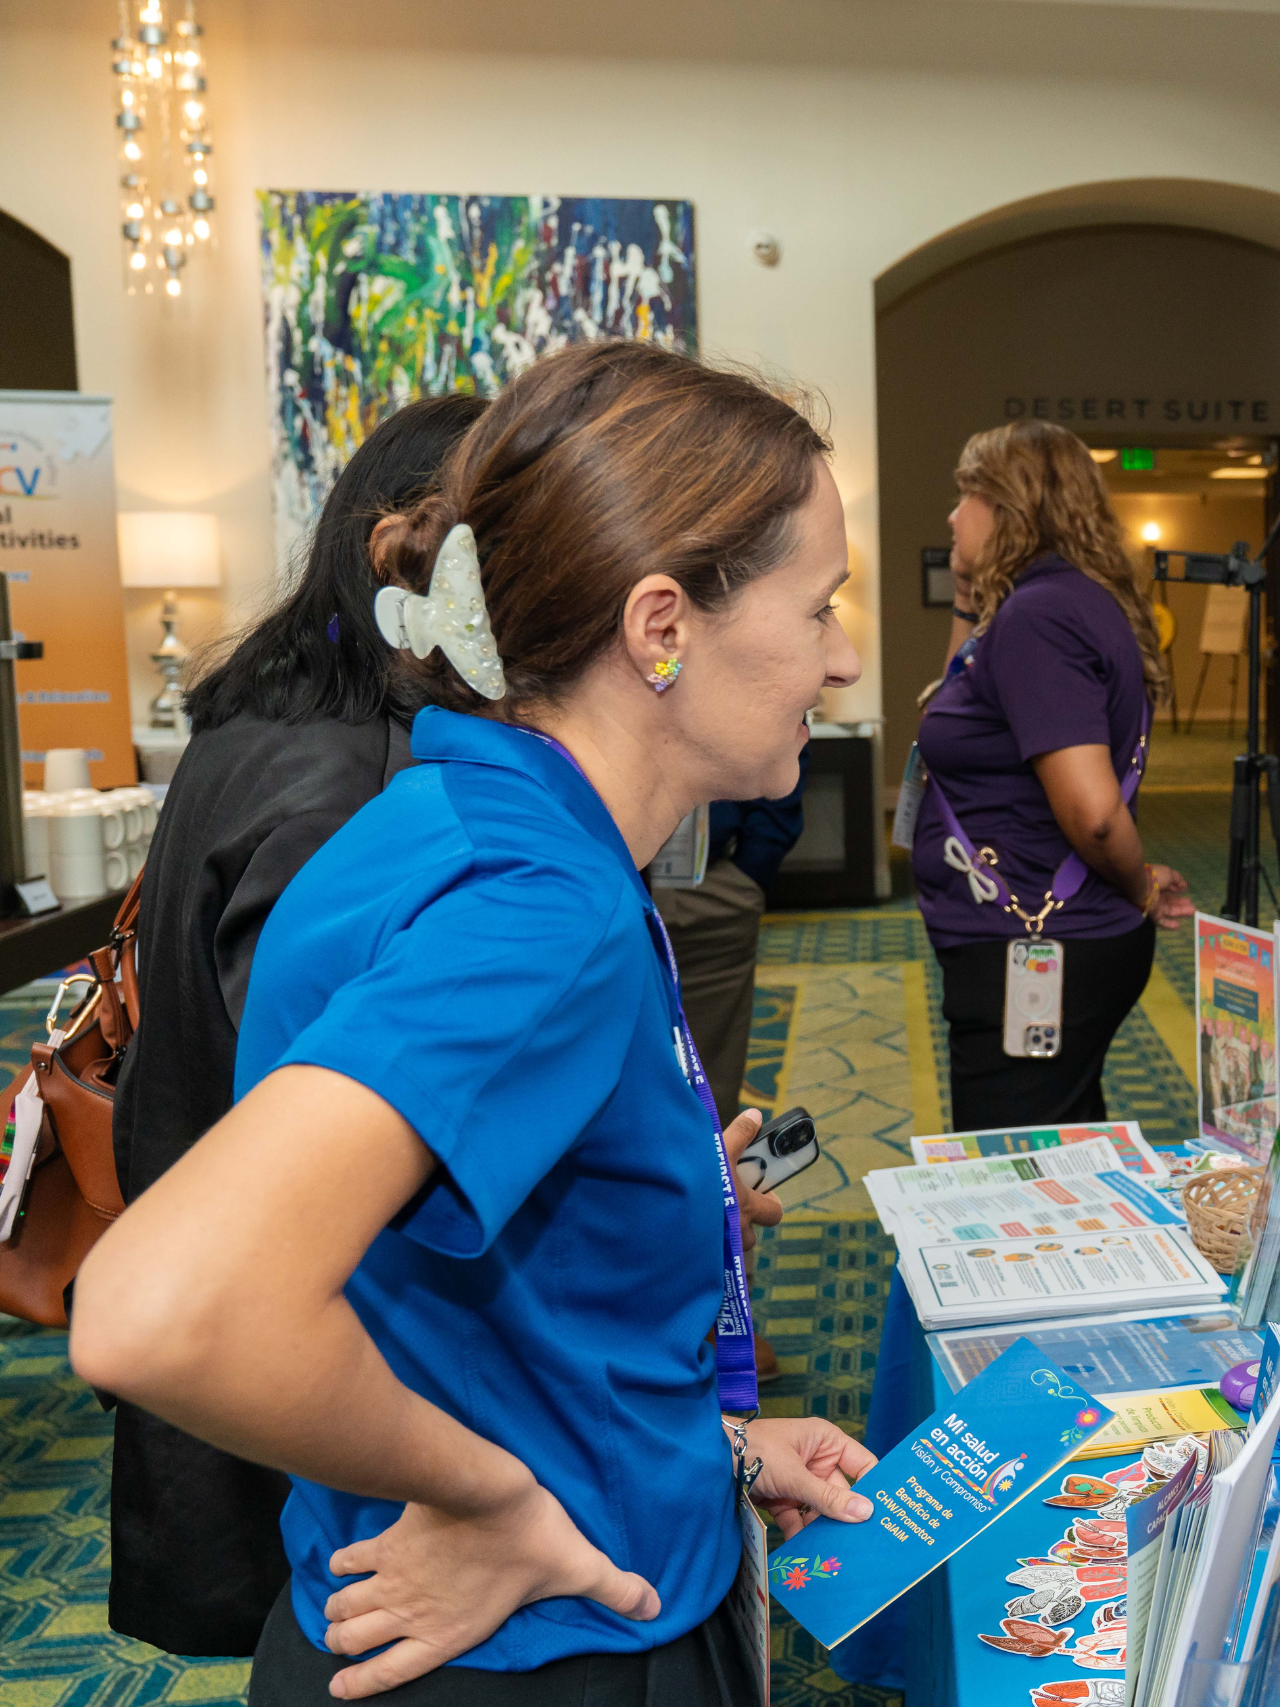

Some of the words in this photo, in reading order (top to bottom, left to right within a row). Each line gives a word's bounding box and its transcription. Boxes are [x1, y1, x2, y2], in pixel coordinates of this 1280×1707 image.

[1004, 397, 1149, 421] DESERT
[1163, 399, 1269, 422] SUITE
[910, 1440, 936, 1470] Visión
[930, 1427, 950, 1448] en
[946, 1440, 990, 1482] acción
[944, 1412, 968, 1437] Mi
[959, 1430, 1000, 1464] salud
[875, 1489, 936, 1546] CHW/Promotora
[894, 1486, 930, 1522] Beneficio
[927, 1515, 941, 1530] de
[905, 1475, 943, 1512] Programa
[941, 1506, 954, 1521] de
[879, 1516, 909, 1543] CalAIM
[1146, 1512, 1168, 1535] CAPAC
